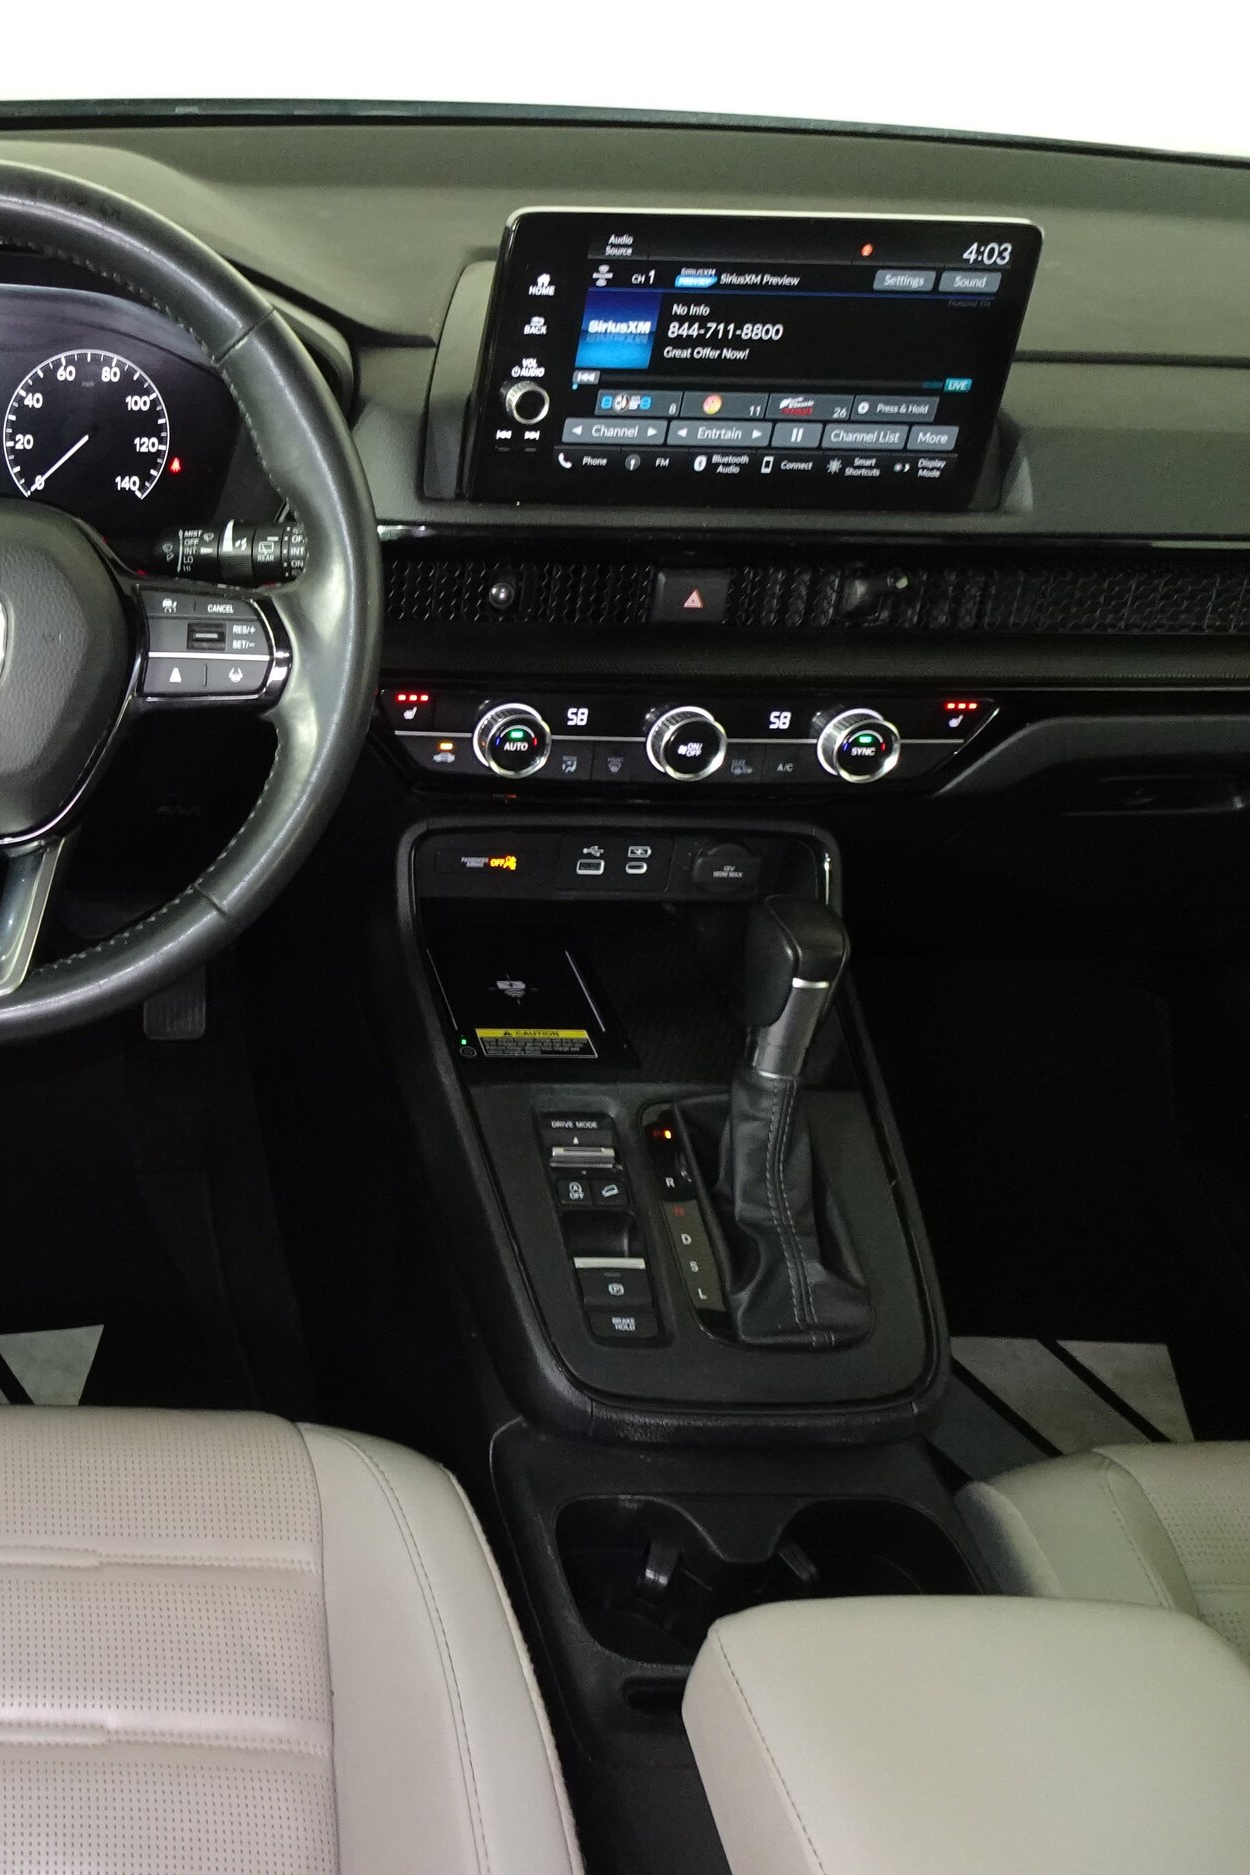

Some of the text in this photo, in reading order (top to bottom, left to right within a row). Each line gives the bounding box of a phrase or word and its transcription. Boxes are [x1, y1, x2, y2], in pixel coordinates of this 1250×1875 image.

[608, 235, 633, 246] Audio
[605, 246, 632, 256] Source
[962, 242, 1012, 265] 4:03
[631, 269, 655, 285] CH 1
[720, 274, 800, 286] SiriusXM Preview
[883, 274, 925, 288] Settings
[953, 277, 987, 288] Sound
[528, 285, 555, 296] HOME
[672, 304, 710, 316] No Info
[523, 324, 547, 335] BACK
[588, 320, 651, 334] SiriusXM
[668, 322, 784, 341] 844-711-8800
[663, 346, 749, 360] Great Offer Now!
[522, 358, 538, 368] VOL
[56, 365, 76, 381] 60
[101, 367, 120, 382] 80
[520, 367, 545, 377] AUDIO
[949, 380, 966, 391] LIVE
[23, 392, 43, 408] 40
[125, 395, 150, 410] 100
[749, 405, 761, 416] 11
[833, 407, 847, 418] 26
[876, 403, 899, 414] Press
[908, 403, 929, 414] Hold
[591, 425, 639, 438] Channel
[697, 427, 742, 440] Entrtain
[830, 430, 899, 443] Channel List
[15, 433, 34, 450] 20
[917, 431, 948, 444] More
[134, 437, 159, 452] 120
[582, 456, 607, 466] Phone
[655, 458, 669, 467] FM
[712, 454, 749, 464] Bluetooth
[780, 459, 813, 470] Connect
[854, 455, 876, 466] Smart
[918, 457, 946, 469] Display
[716, 463, 740, 474] Audio
[844, 465, 881, 477] Shortcuts
[918, 467, 940, 478] Mode
[115, 476, 140, 491] 140
[184, 547, 196, 555] INT
[290, 546, 305, 556] INT
[183, 556, 194, 564] LO
[290, 559, 304, 568] ON
[207, 604, 235, 614] CANCEL
[567, 708, 589, 726] 58
[769, 711, 792, 730] 58
[503, 742, 528, 752] AUTO
[687, 743, 702, 751] ON/
[851, 747, 876, 757] SYNC
[685, 750, 701, 758] OFF
[777, 763, 793, 772] A/C
[490, 858, 505, 867] OFF
[551, 1120, 598, 1129] DRIVE MODE
[666, 1177, 675, 1188] R
[681, 1233, 692, 1245] D
[698, 1288, 707, 1300] L
[612, 1317, 635, 1325] BRAKE
[614, 1324, 636, 1332] HOLD
